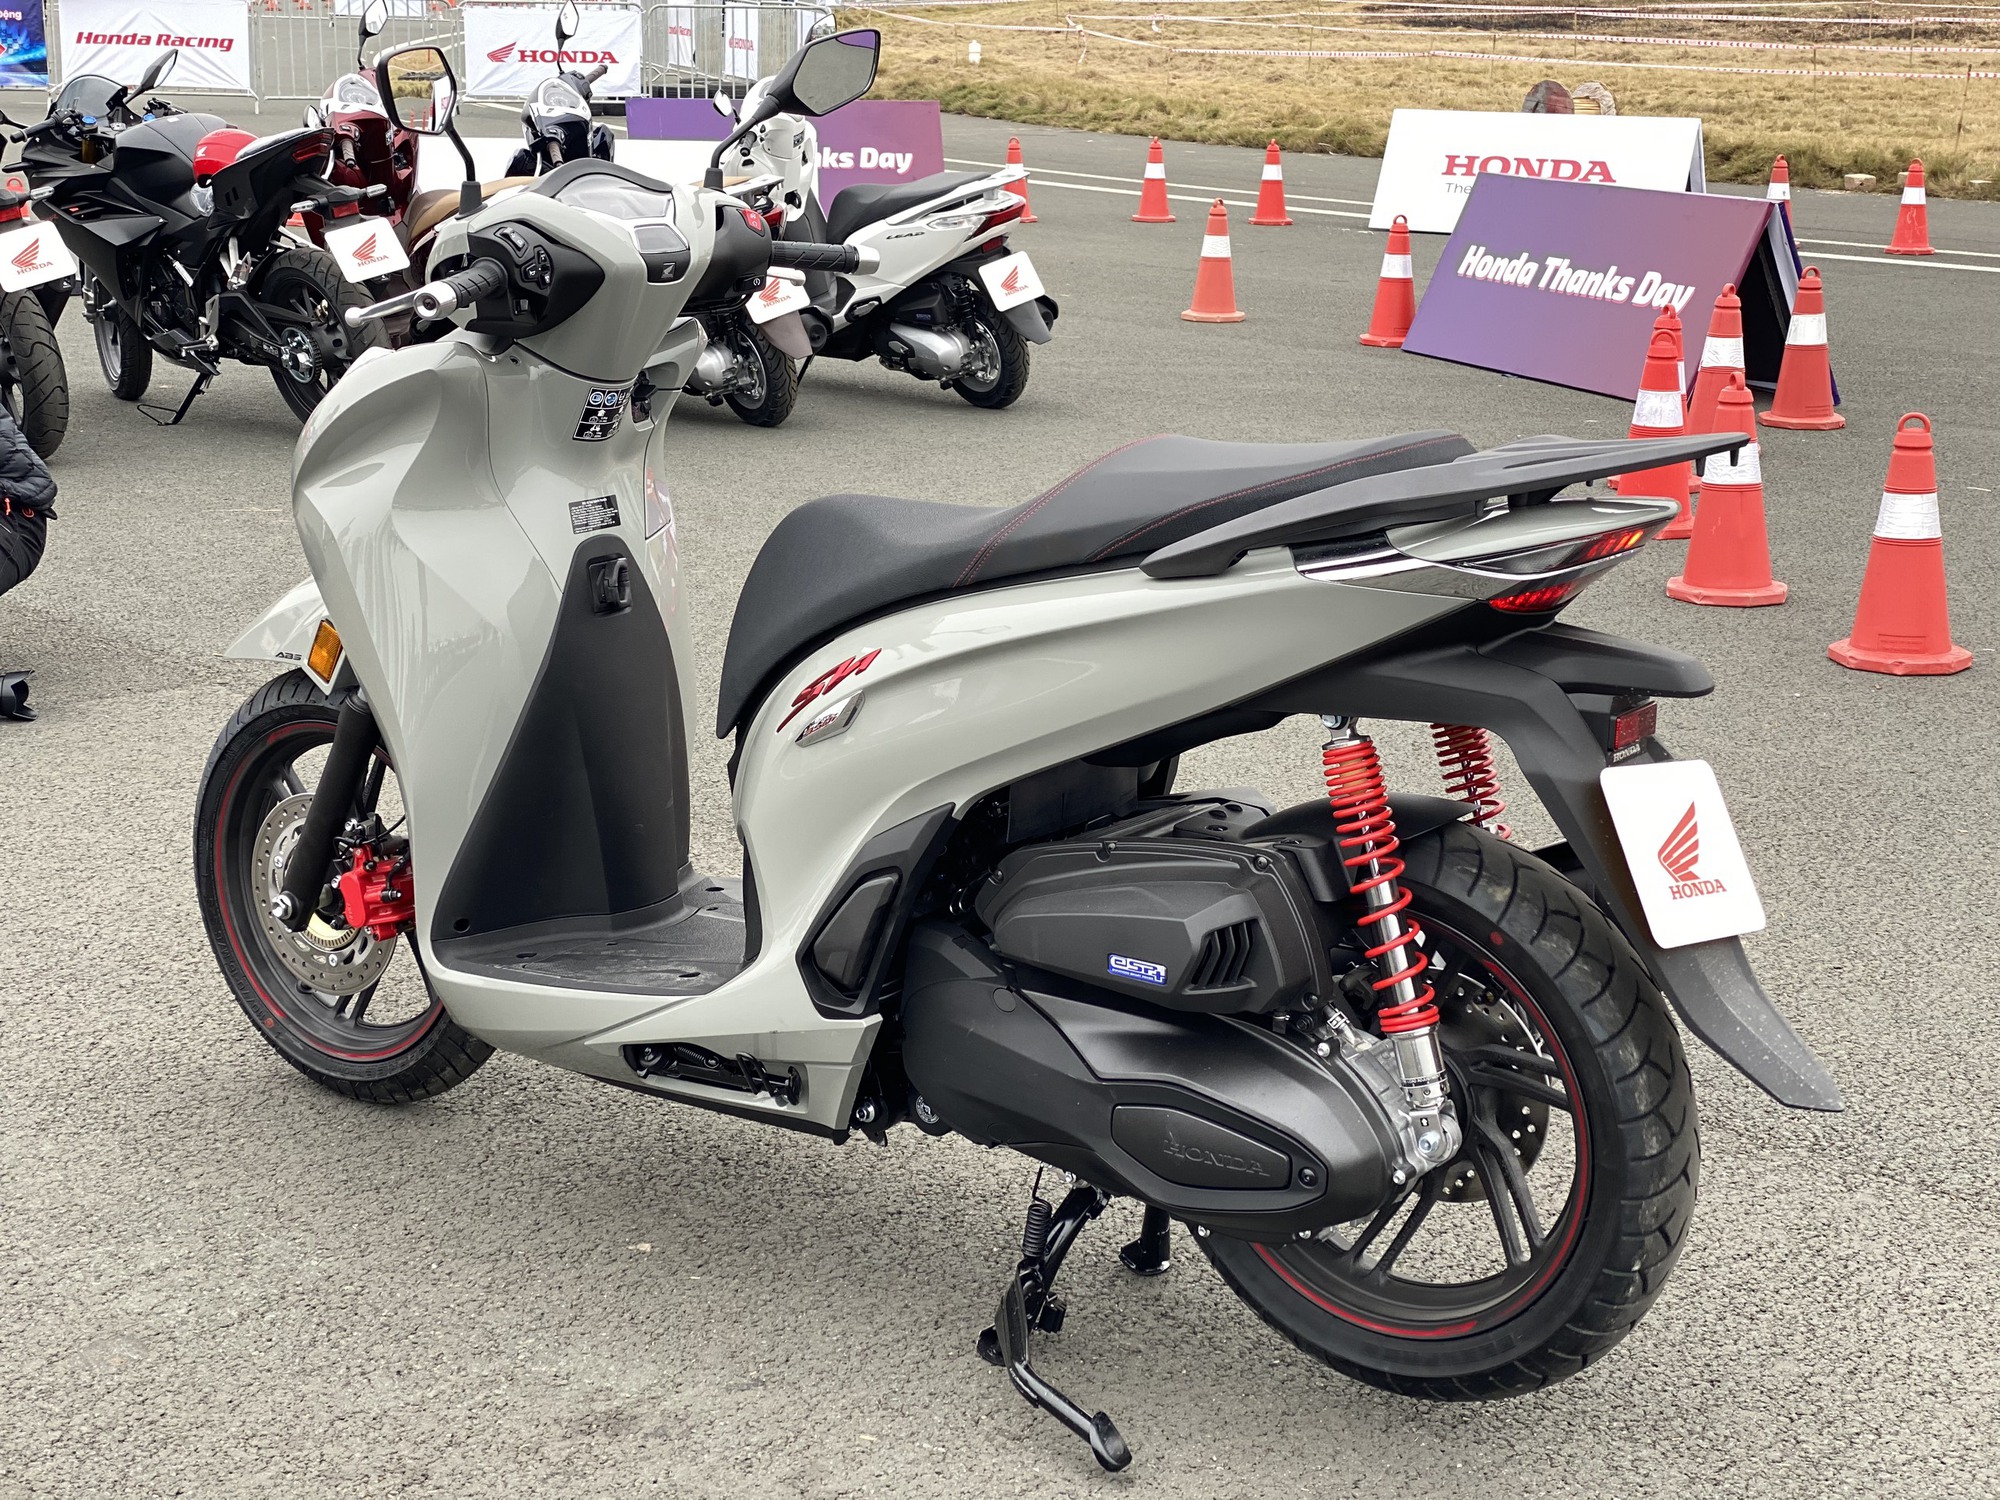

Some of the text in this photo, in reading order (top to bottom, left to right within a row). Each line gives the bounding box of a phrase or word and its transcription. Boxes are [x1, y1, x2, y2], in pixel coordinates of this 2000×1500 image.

[76, 32, 234, 52] Honda Racing
[518, 50, 619, 64] HONDA
[860, 147, 914, 175] Day
[1441, 155, 1617, 183] HONDA
[1445, 183, 1473, 195] The
[886, 231, 925, 240] LEAD
[16, 261, 54, 275] HONDA
[357, 255, 389, 267] HONDA
[1457, 245, 1696, 314] Honda Thanks Day
[1004, 284, 1029, 297] HONDA
[763, 295, 791, 308] HONDA
[275, 651, 302, 661] ABS
[1612, 743, 1641, 763] HONDA
[1668, 879, 1727, 900] HONDA
[1163, 1139, 1271, 1176] HONDA
